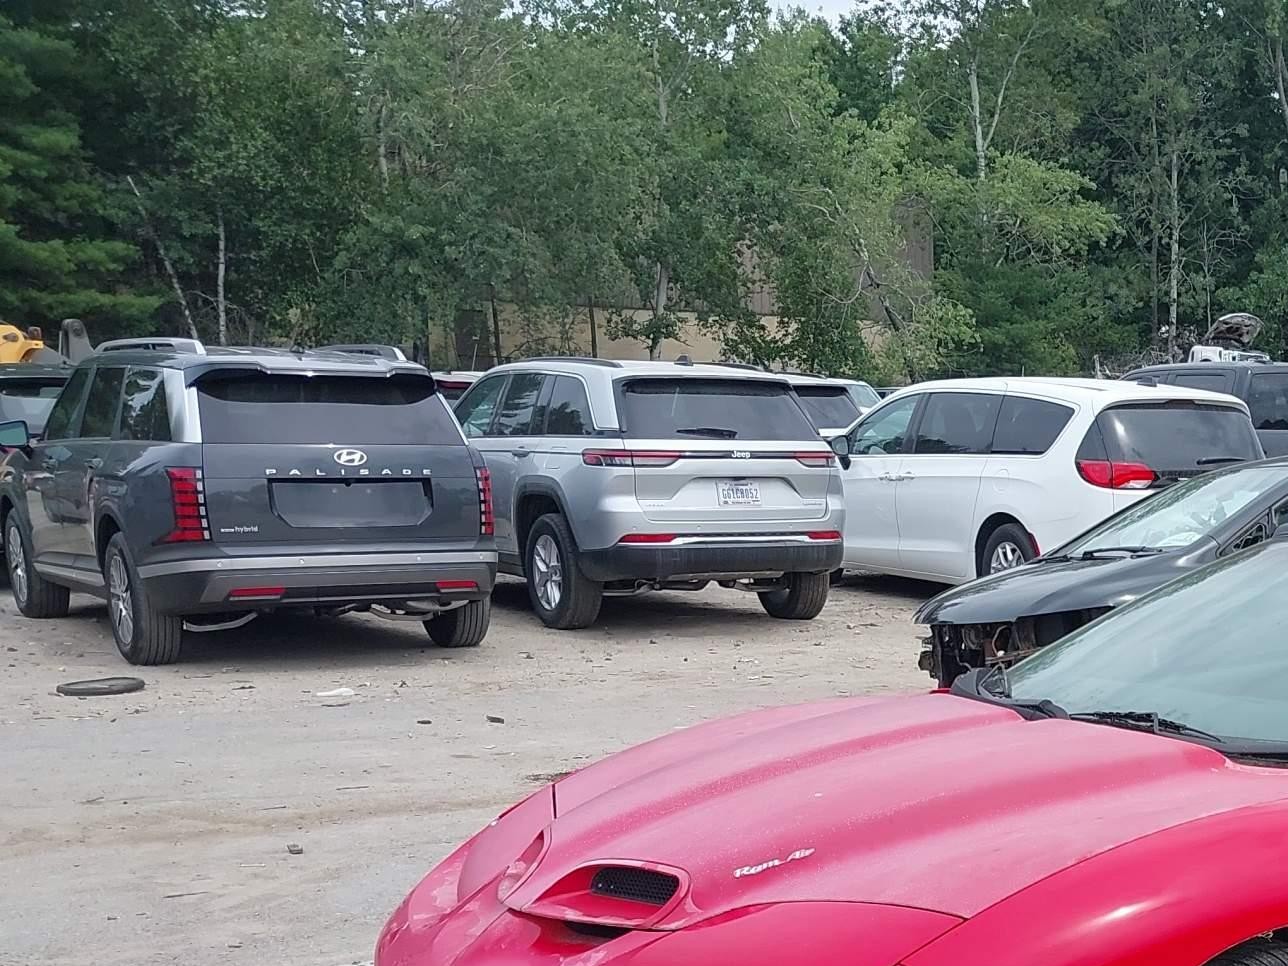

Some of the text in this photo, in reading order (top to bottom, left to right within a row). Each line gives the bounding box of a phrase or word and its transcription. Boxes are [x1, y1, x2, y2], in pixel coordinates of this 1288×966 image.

[731, 449, 751, 459] Jeep
[265, 468, 433, 476] PALISADE
[234, 525, 259, 534] hybrid
[733, 847, 816, 879] Ram Air
